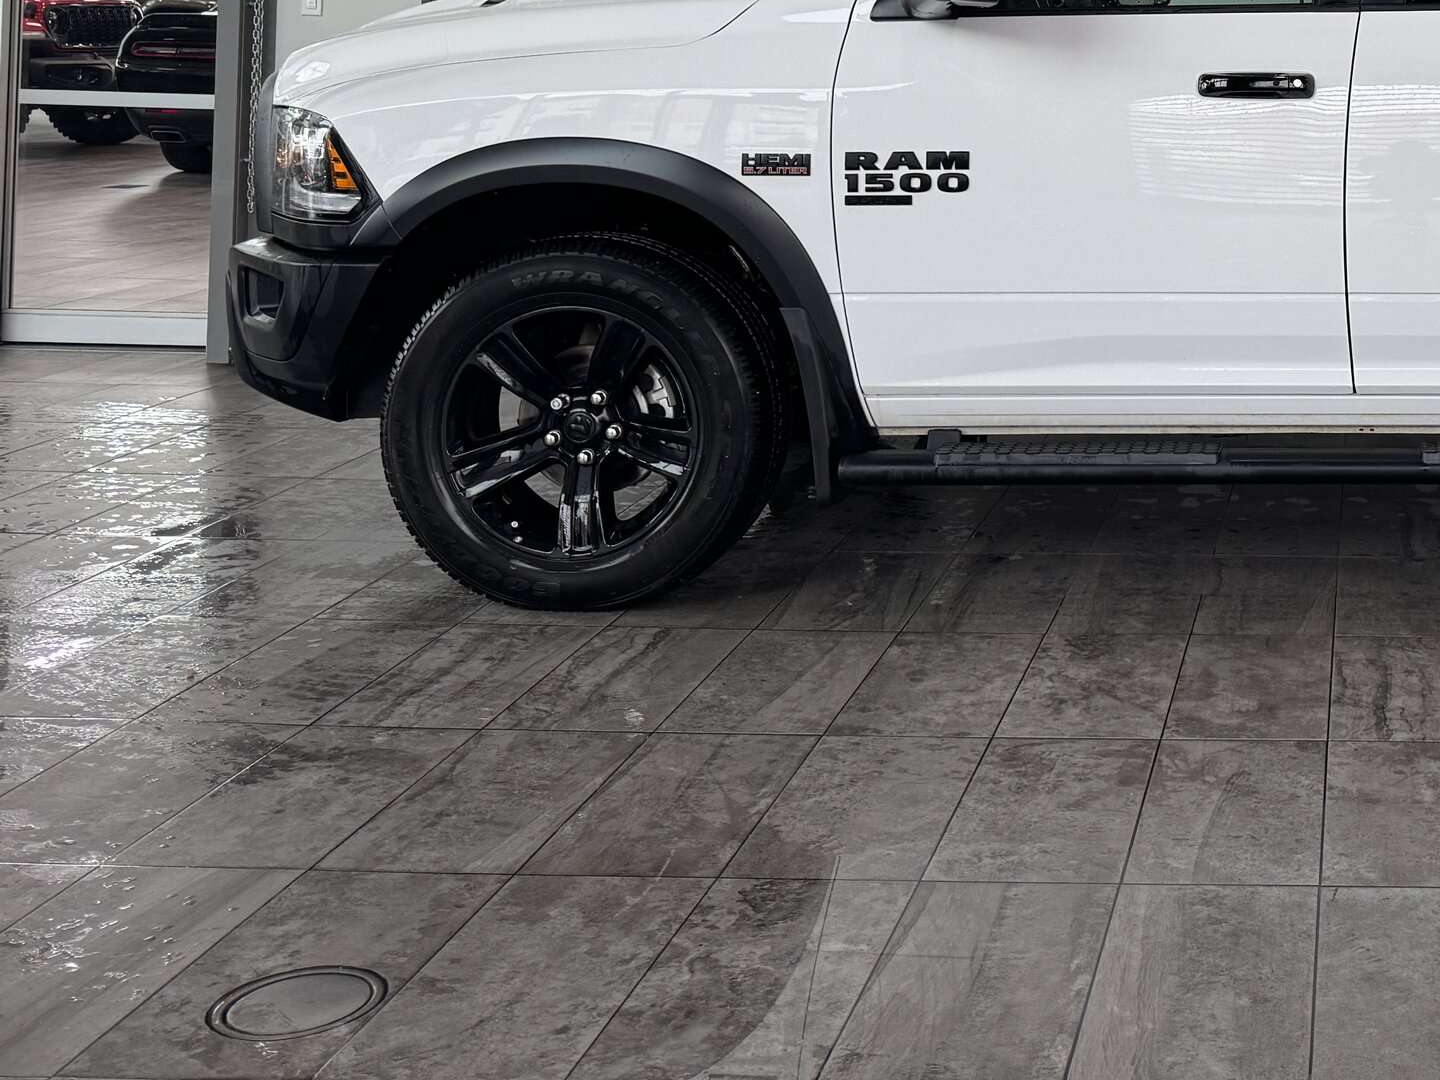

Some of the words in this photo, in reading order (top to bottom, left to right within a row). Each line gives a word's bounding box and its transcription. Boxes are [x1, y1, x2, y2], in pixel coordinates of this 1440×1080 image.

[741, 153, 811, 167] HEMI
[844, 151, 970, 171] RAM
[768, 166, 808, 175] LITER
[844, 173, 970, 193] 1500
